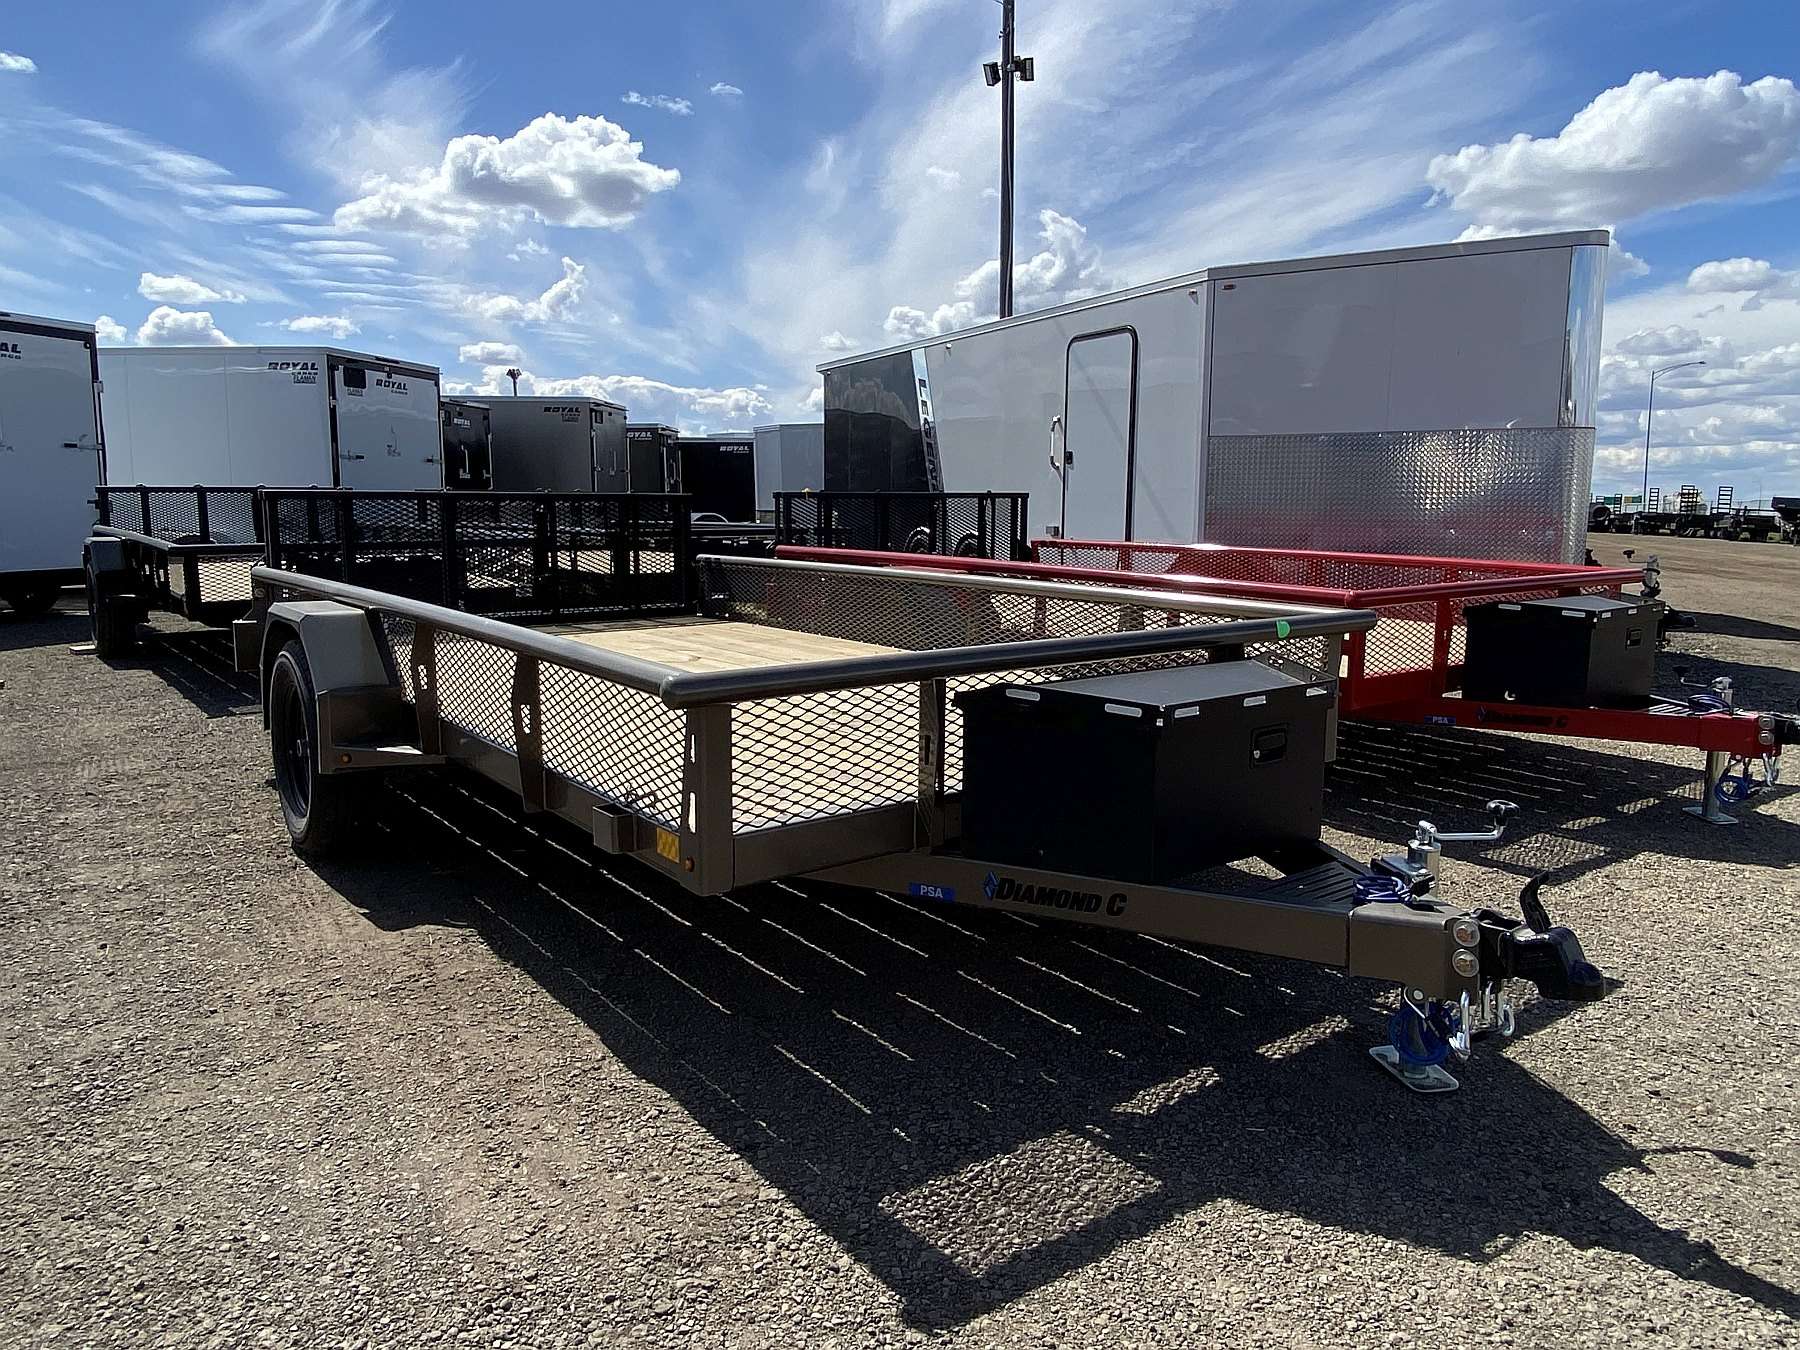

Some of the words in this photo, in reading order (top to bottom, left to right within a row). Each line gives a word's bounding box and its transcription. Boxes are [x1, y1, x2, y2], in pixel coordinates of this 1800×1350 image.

[268, 362, 319, 370] ROYAL
[376, 378, 408, 391] ROYAL
[1432, 715, 1449, 724] PSA
[920, 884, 944, 899] PSA
[995, 877, 1103, 913] DIAMOND
[1105, 892, 1128, 917] C
